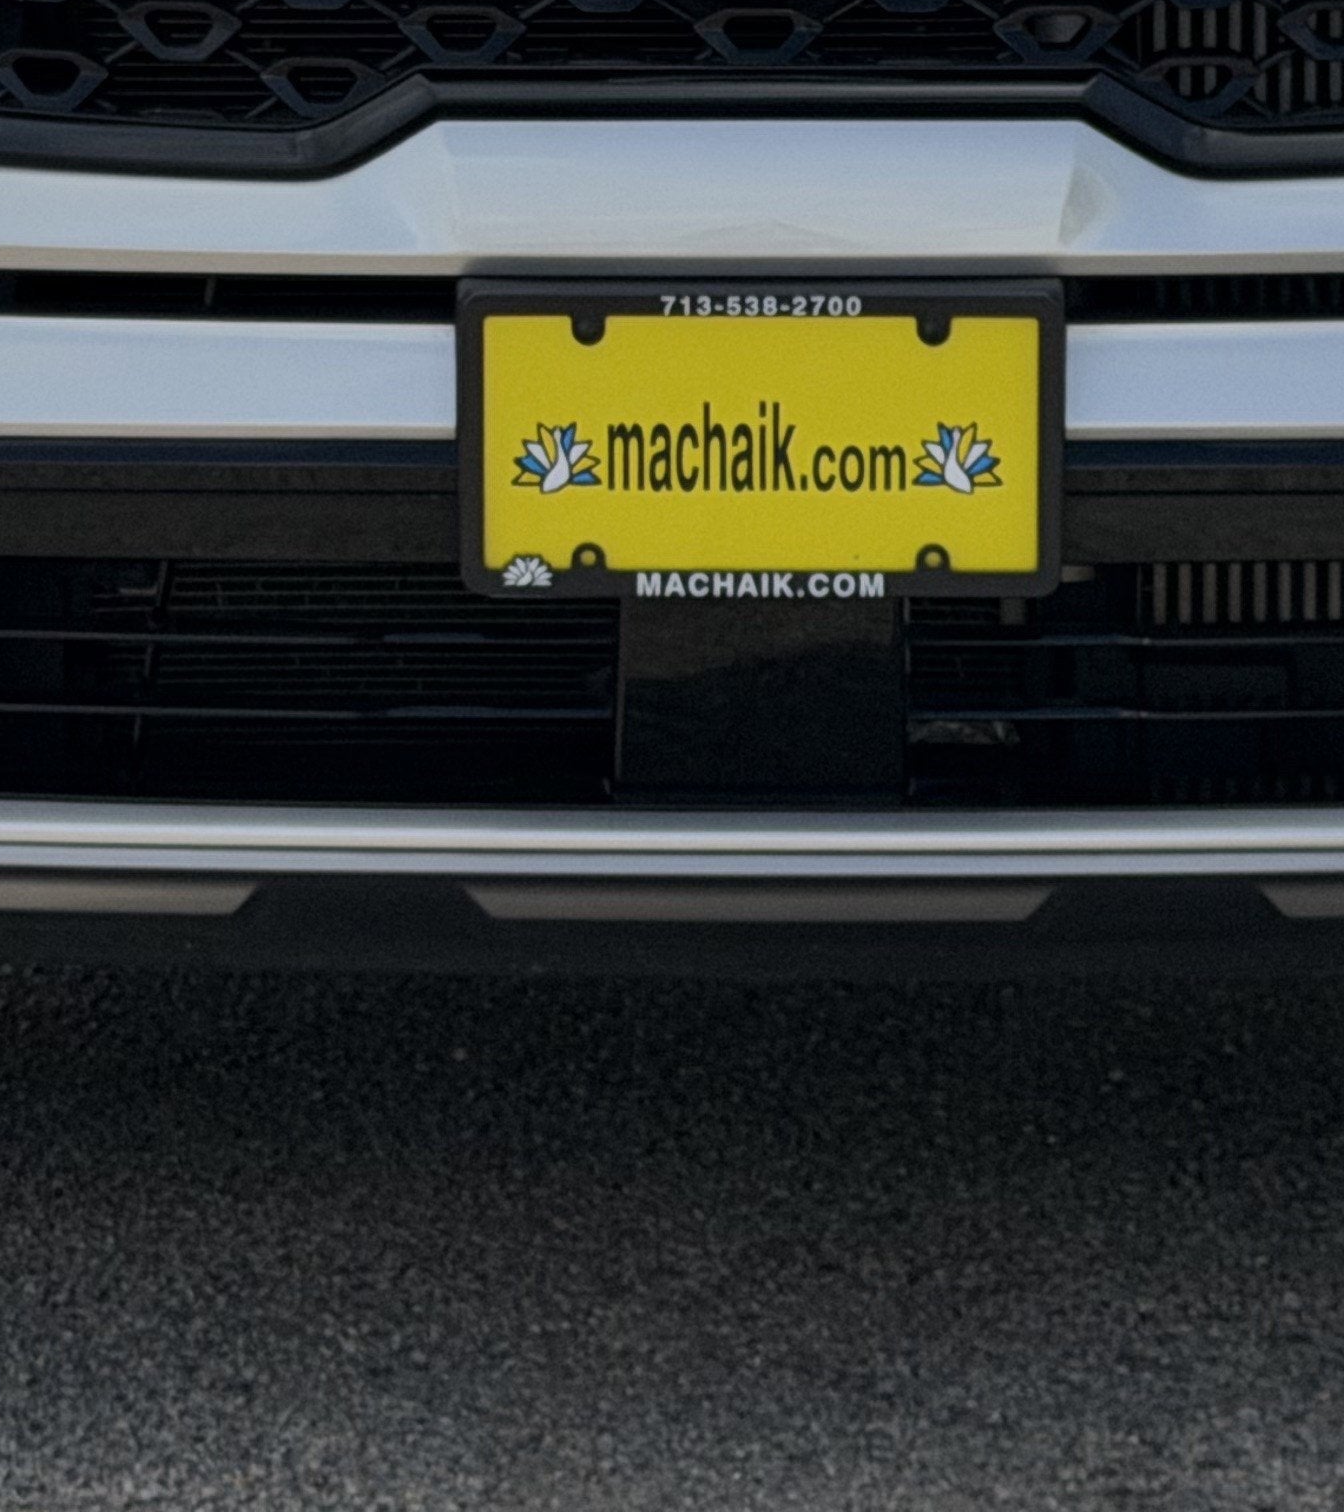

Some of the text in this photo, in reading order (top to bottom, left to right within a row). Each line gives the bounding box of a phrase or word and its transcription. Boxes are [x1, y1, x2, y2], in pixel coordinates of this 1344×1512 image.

[661, 295, 862, 317] 713-538-2700
[607, 401, 906, 491] machaik.com
[637, 572, 885, 598] MACHAIK.COM
